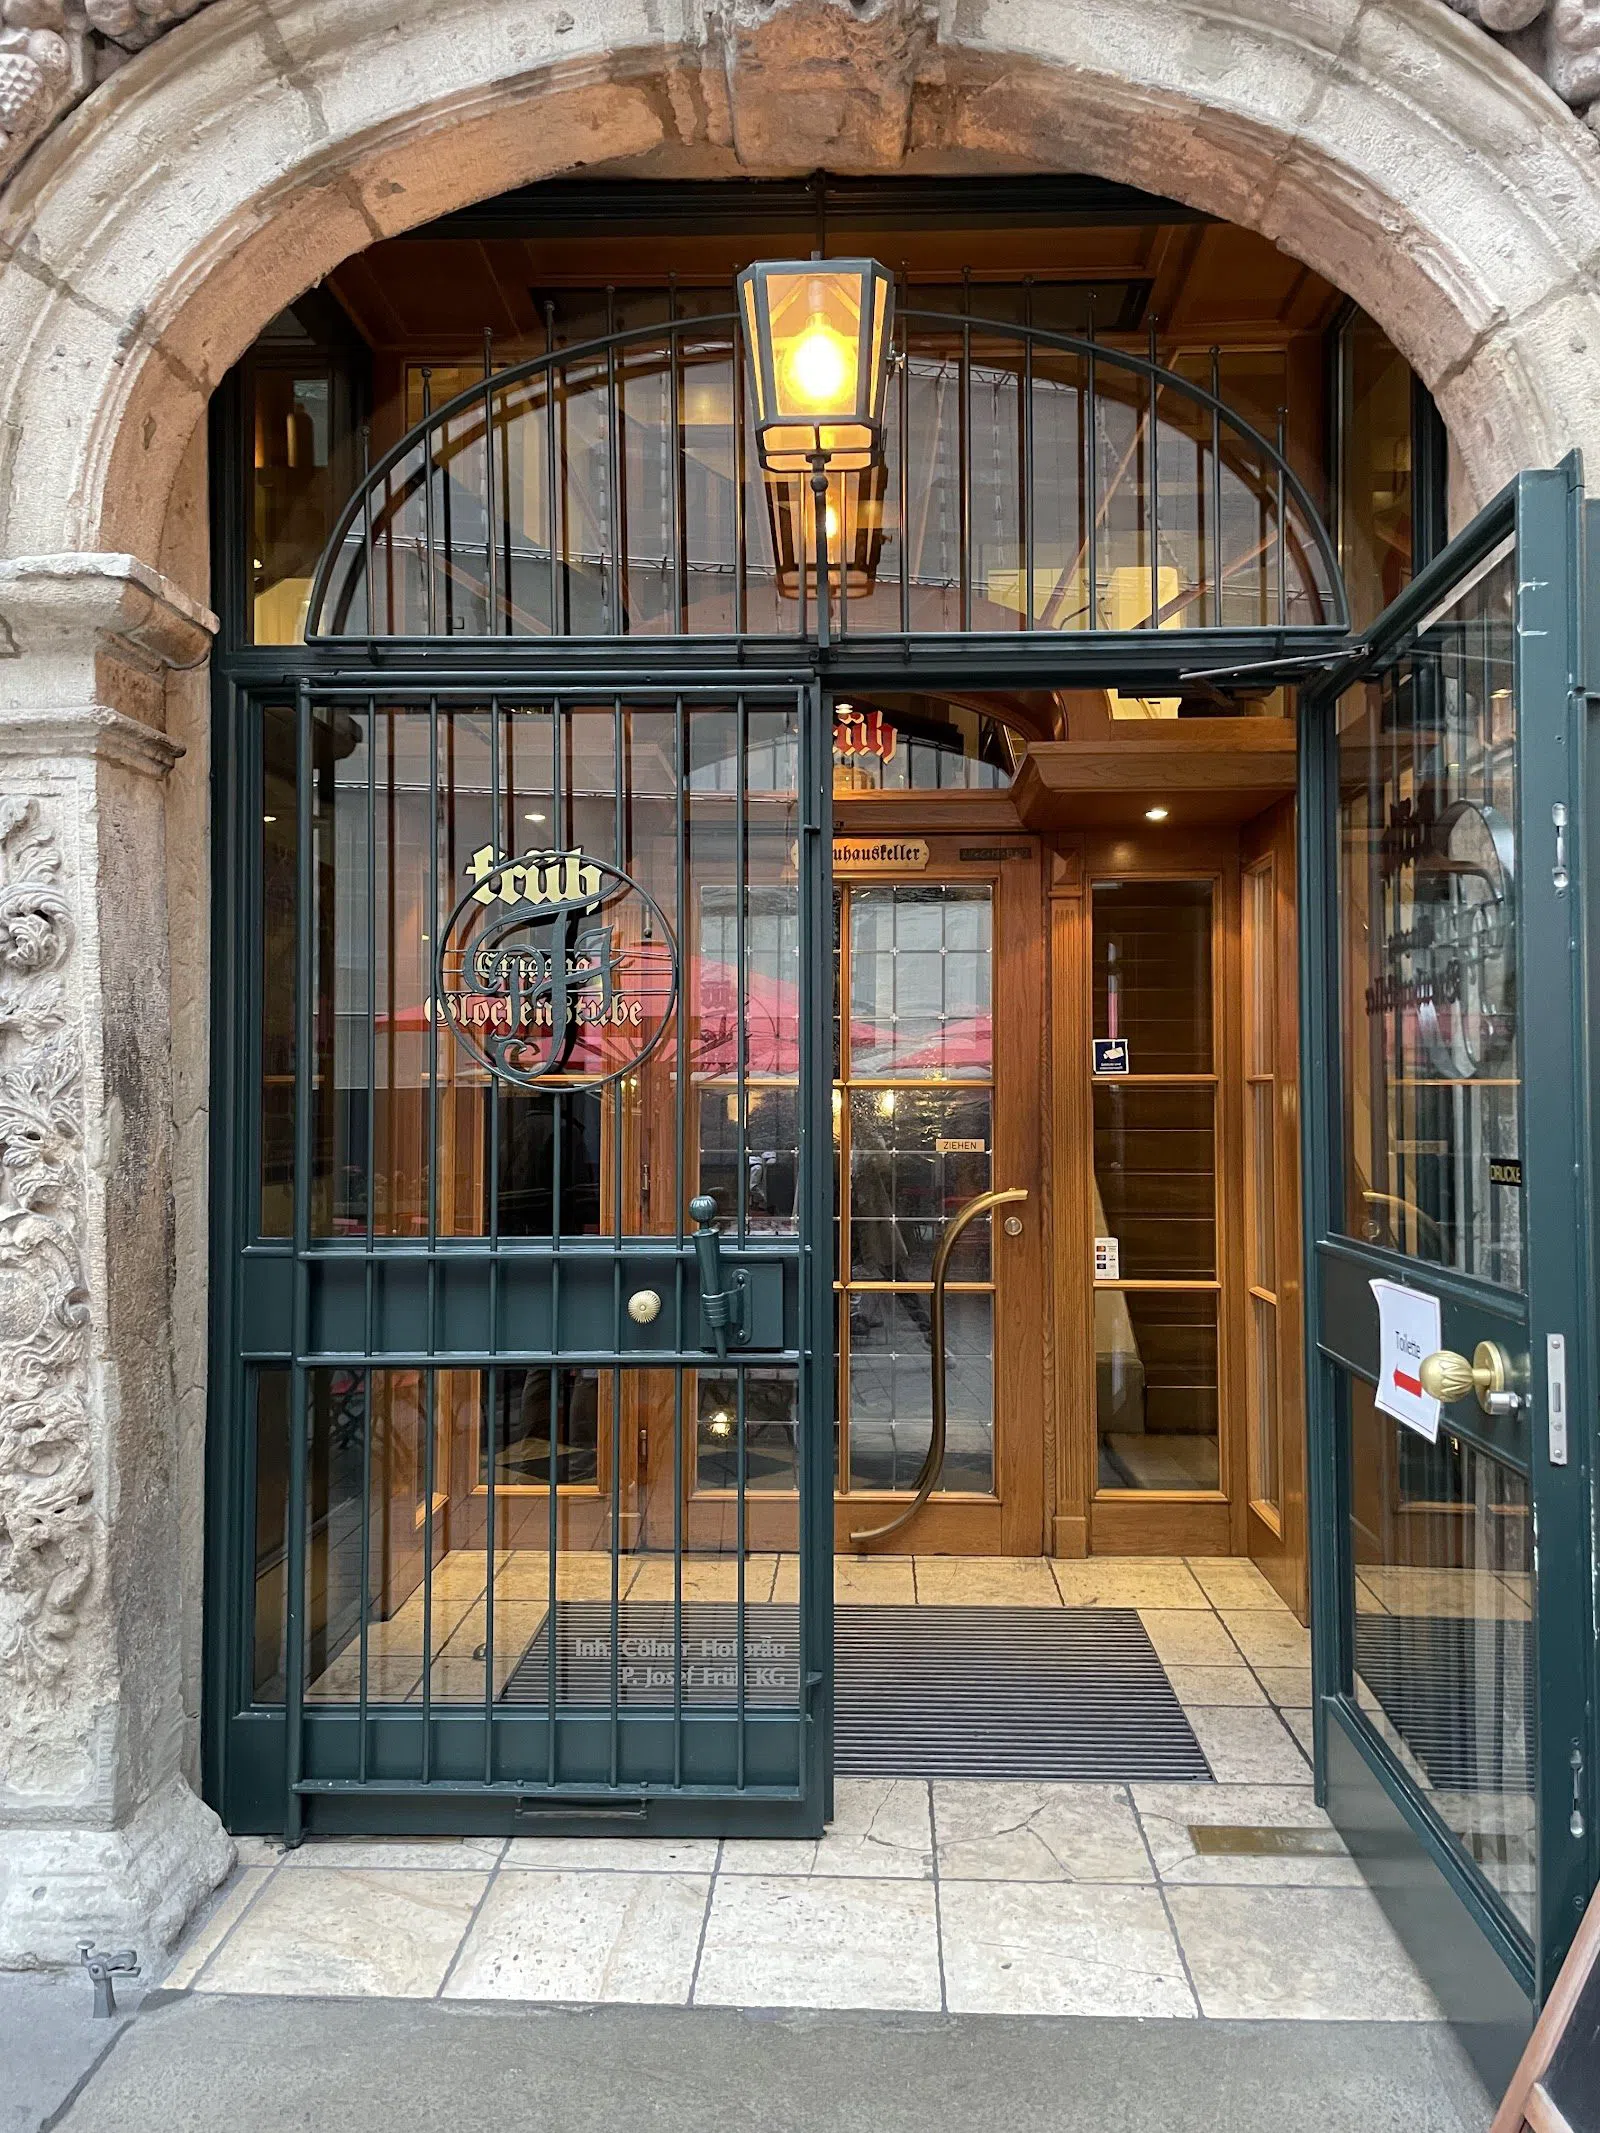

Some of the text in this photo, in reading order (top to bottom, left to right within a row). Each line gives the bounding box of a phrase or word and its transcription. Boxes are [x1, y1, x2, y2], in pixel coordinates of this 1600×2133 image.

[943, 1141, 977, 1150] ZIEHEN
[1394, 1330, 1421, 1359] Toilette
[575, 1638, 612, 1657] Inh.
[622, 1638, 691, 1657] Cölnr
[622, 1667, 638, 1685] P.
[755, 1667, 785, 1686] KG
